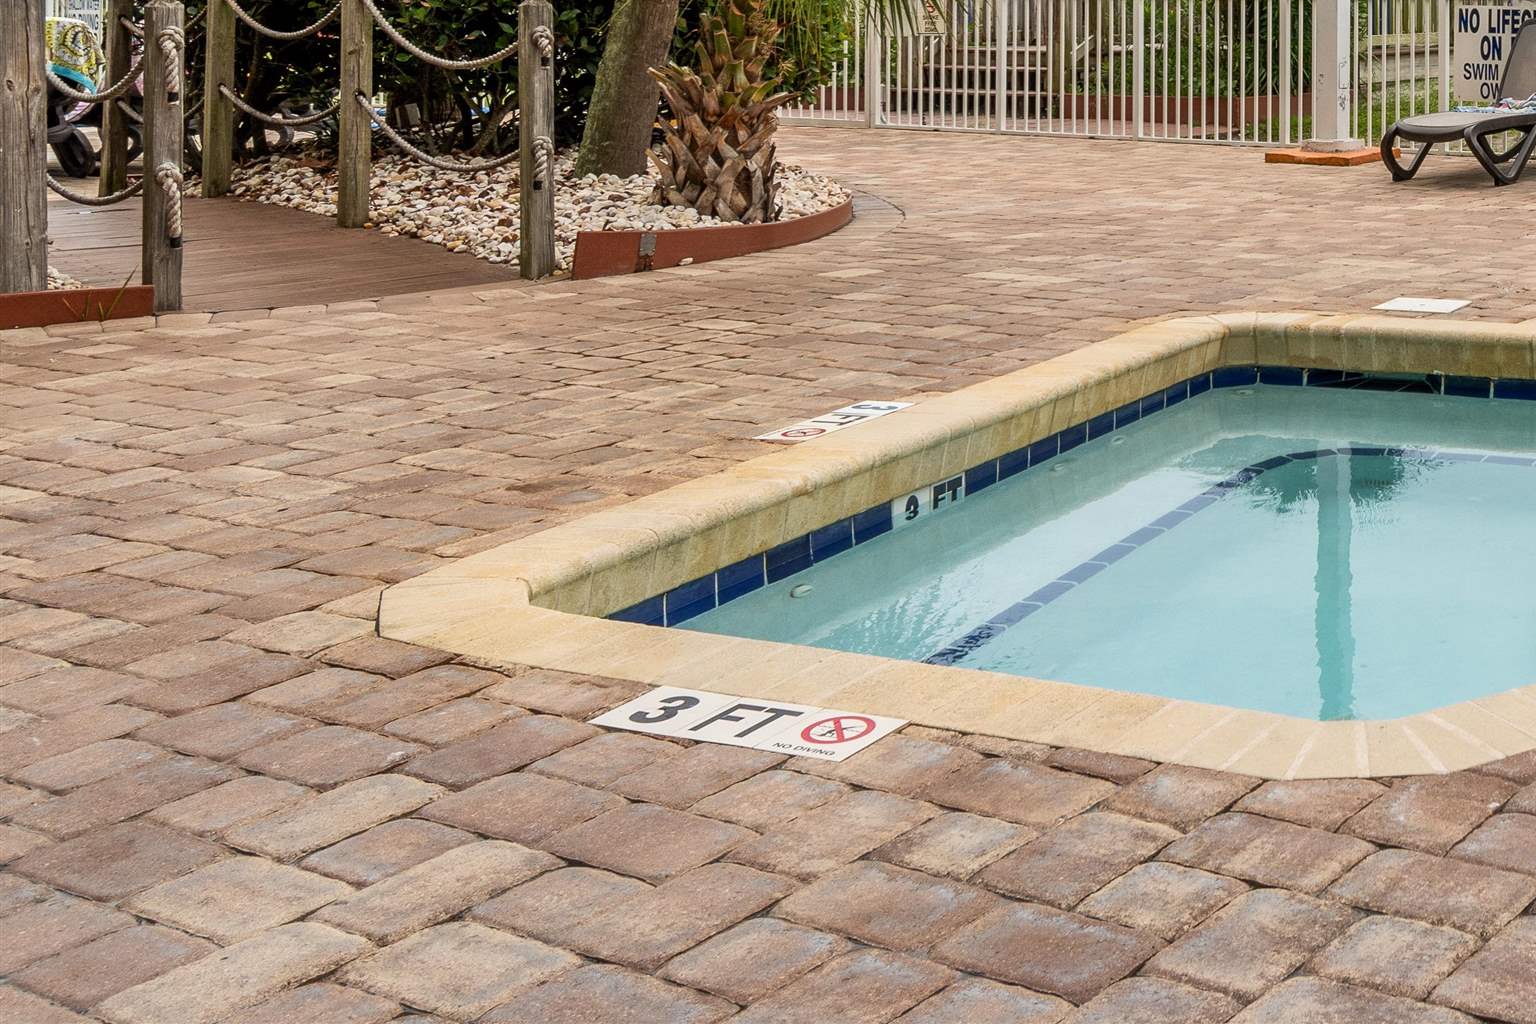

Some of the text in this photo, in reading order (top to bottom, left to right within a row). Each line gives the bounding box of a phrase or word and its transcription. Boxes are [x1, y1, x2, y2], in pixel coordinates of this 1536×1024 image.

[1458, 8, 1480, 33] NO
[1480, 36, 1502, 60] ON
[1464, 62, 1498, 80] SWIM
[932, 475, 964, 510] FT
[629, 695, 804, 738] 3 FT
[794, 745, 836, 756] DIVING
